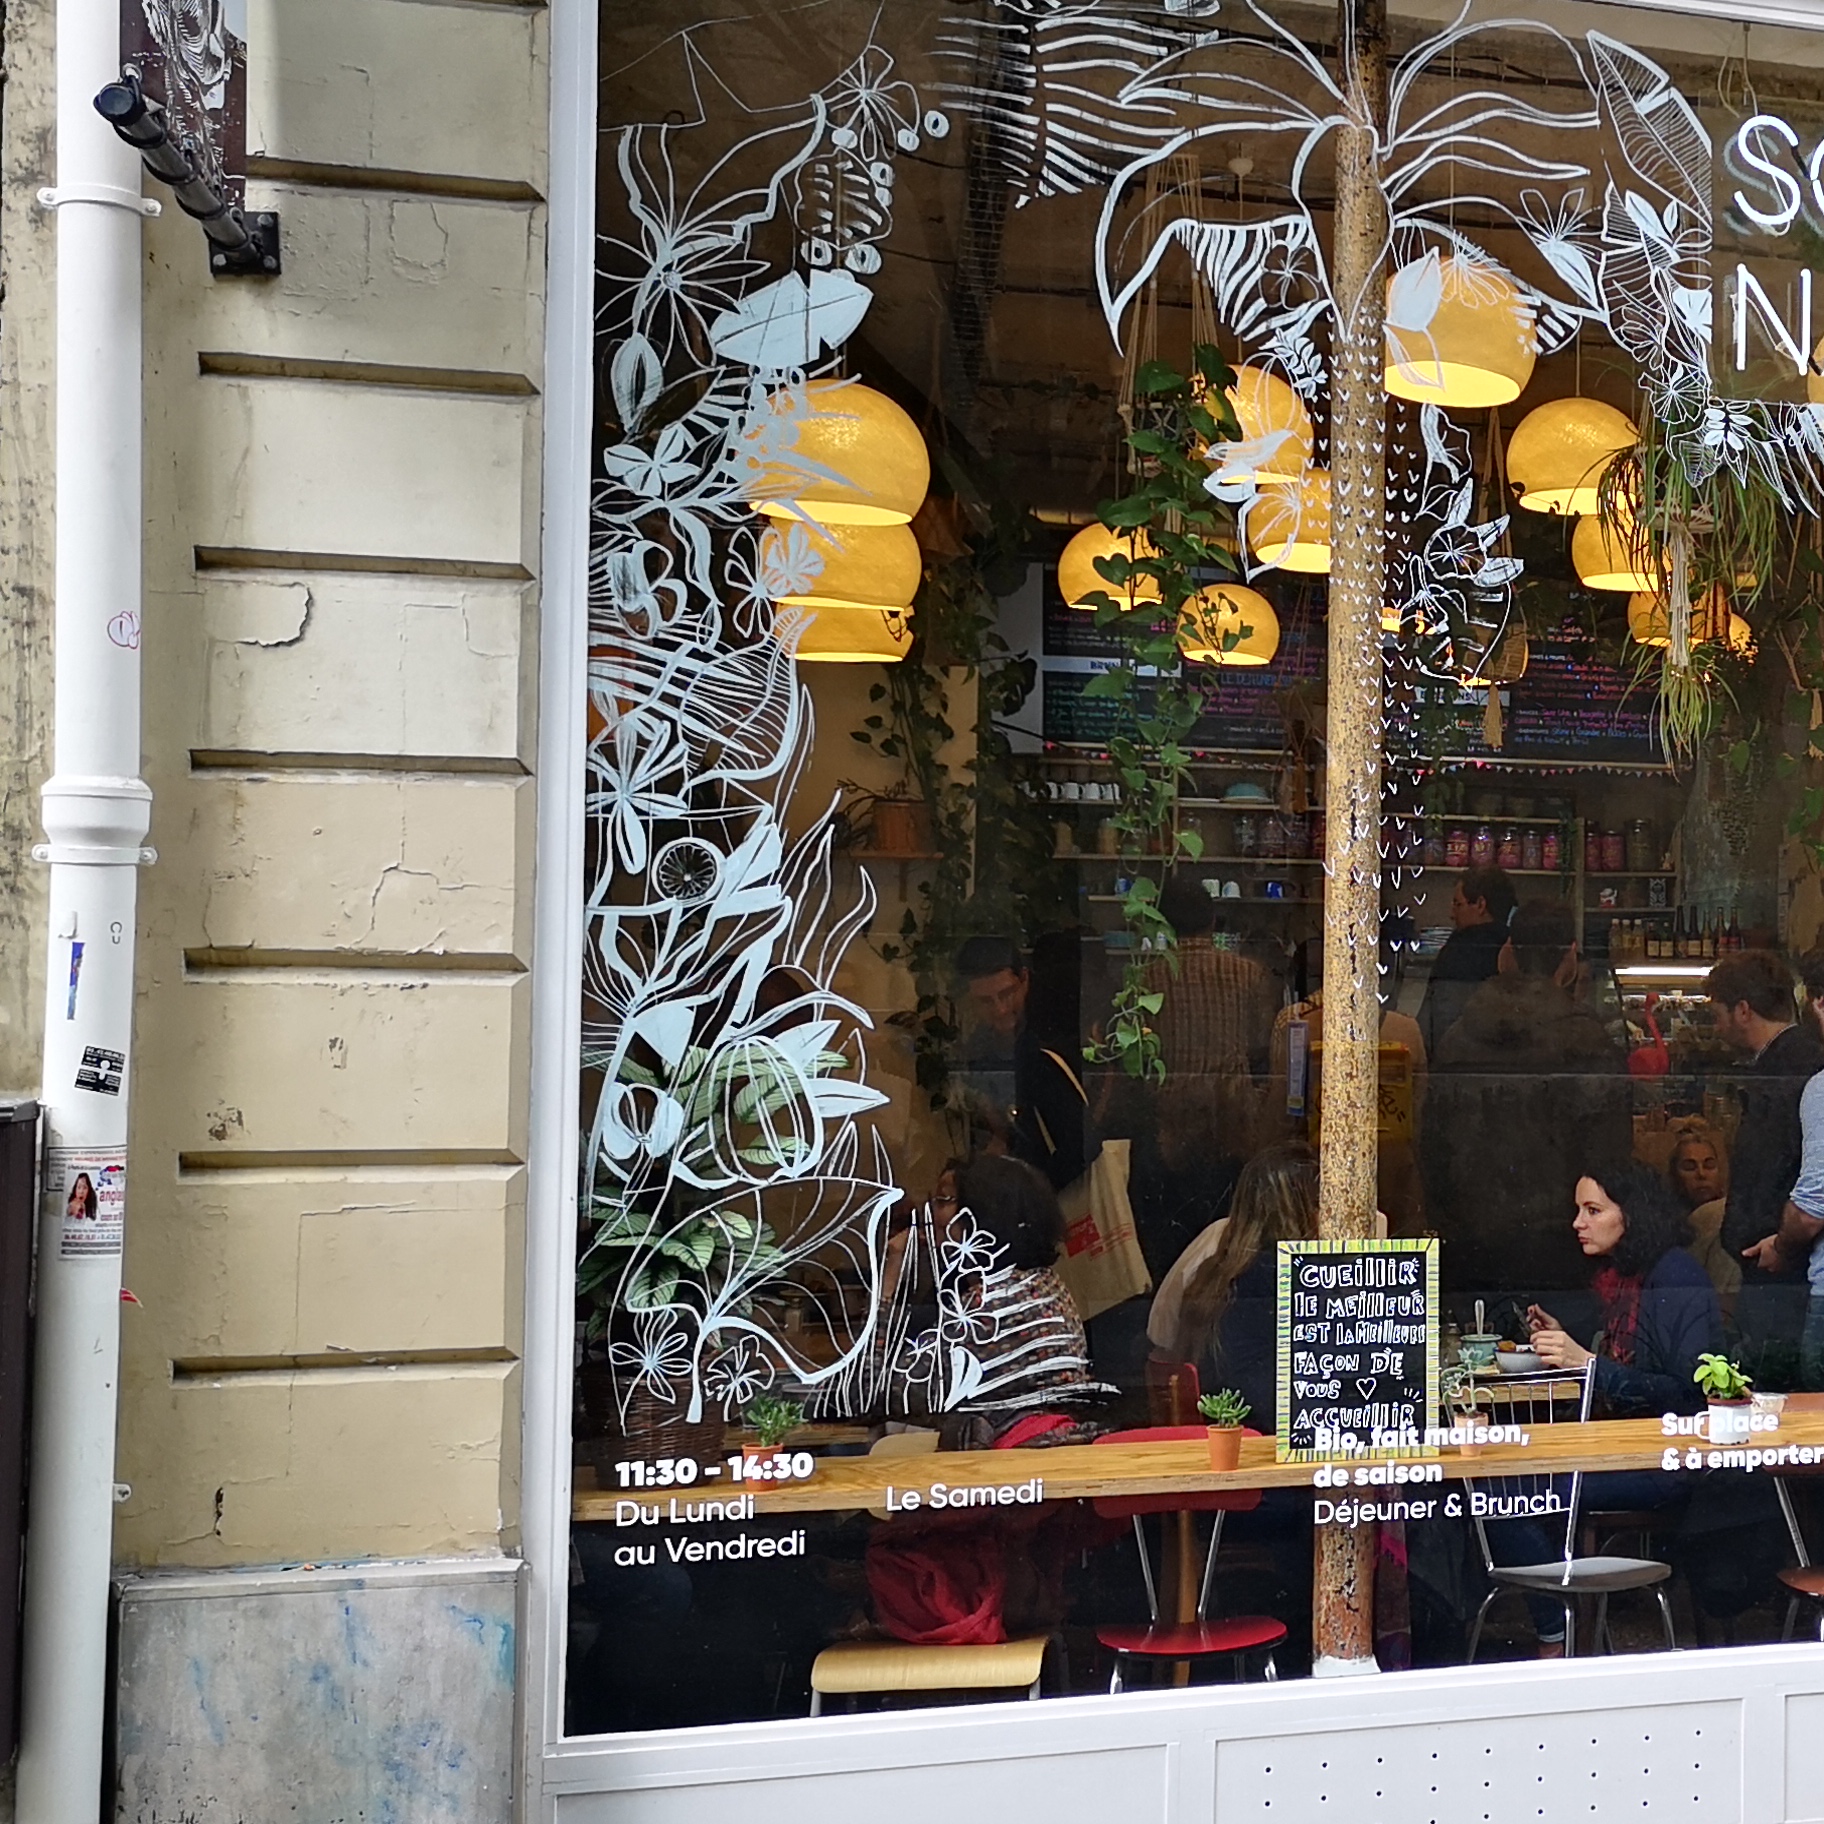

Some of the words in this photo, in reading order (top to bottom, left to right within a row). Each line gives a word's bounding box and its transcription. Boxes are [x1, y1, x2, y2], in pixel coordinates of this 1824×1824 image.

[1293, 1322, 1331, 1343] EST
[1293, 1351, 1360, 1379] FAÇON
[1370, 1351, 1404, 1376] DE
[1314, 1426, 1366, 1453] Bio,
[1371, 1425, 1420, 1448] fait
[1424, 1419, 1531, 1447] maison,
[1661, 1412, 1705, 1436] Sur
[1713, 1408, 1779, 1438] place
[615, 1458, 698, 1488] 11:30
[727, 1452, 814, 1482] 14:30
[1313, 1463, 1349, 1487] de
[1354, 1459, 1443, 1486] saison
[1661, 1448, 1681, 1471] &
[1685, 1447, 1703, 1469] à
[1707, 1444, 1824, 1473] emporter
[615, 1499, 659, 1527] Du
[668, 1494, 755, 1524] Lundi
[886, 1485, 921, 1513] Le
[928, 1478, 1044, 1509] Samedi
[1314, 1497, 1437, 1528] Déjeuner
[1444, 1496, 1463, 1517] &
[1470, 1489, 1561, 1516] Brunch
[614, 1545, 656, 1566] au
[665, 1530, 806, 1563] Vendredi
